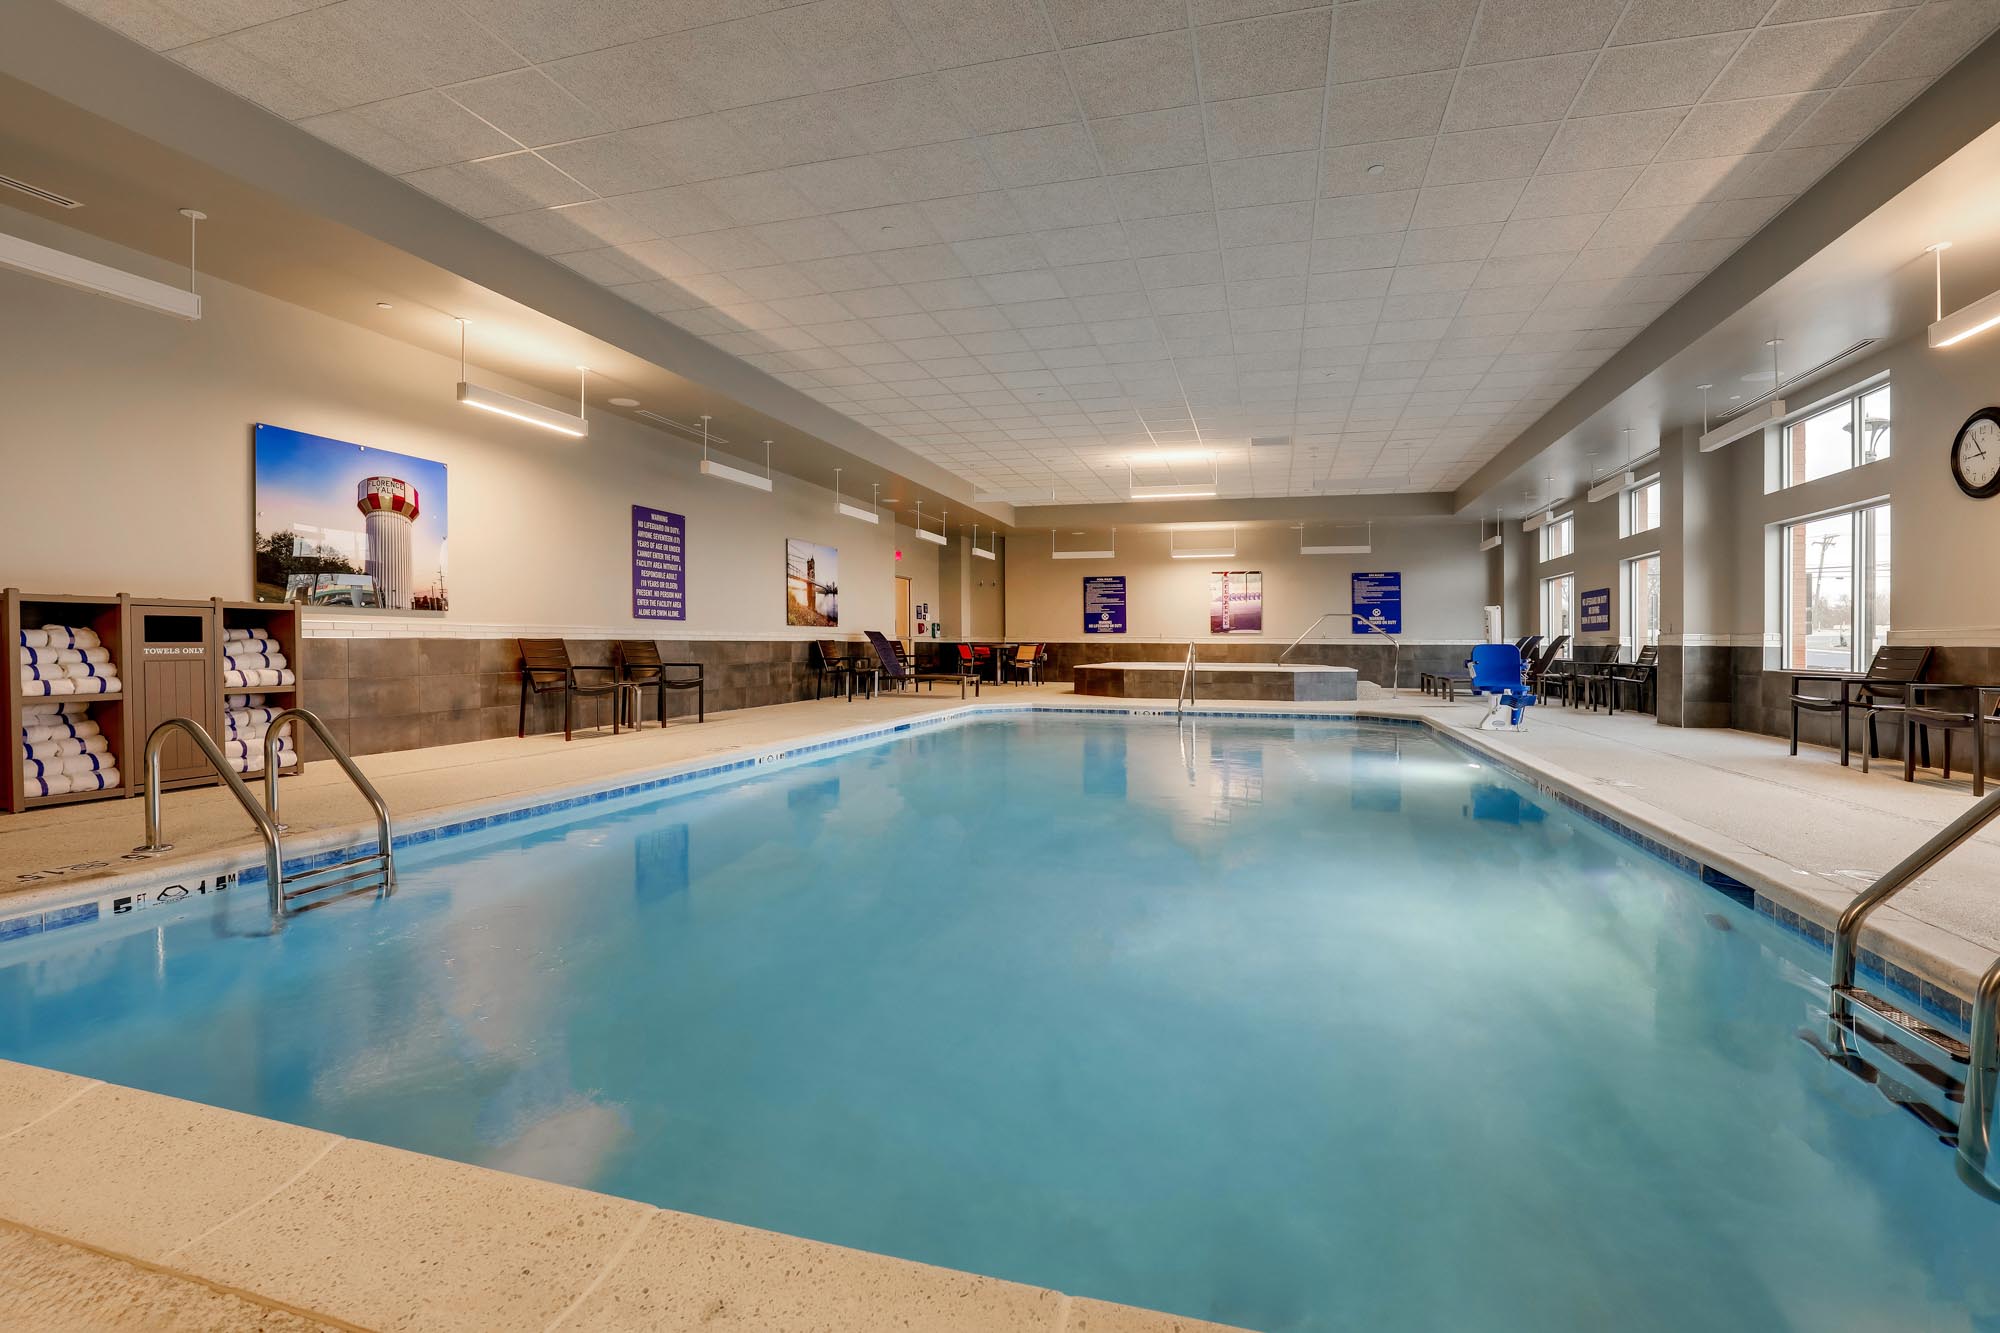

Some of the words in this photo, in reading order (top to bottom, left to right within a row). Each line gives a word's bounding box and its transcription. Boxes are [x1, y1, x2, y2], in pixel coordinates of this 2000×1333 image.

[1980, 425, 1986, 434] 12
[1962, 454, 1968, 462] 9
[1966, 466, 1970, 474] 8
[1990, 467, 1996, 476] 5
[1972, 472, 1977, 481] 7
[1981, 473, 1986, 482] 6
[368, 480, 404, 490] FLORENCE
[651, 513, 668, 522] WARNING
[644, 521, 664, 531] LIFEGUARD
[638, 530, 652, 539] ANYONE
[653, 533, 672, 542] SEVENTEEN
[637, 540, 649, 548] YEARS
[669, 545, 680, 553] UNDER
[641, 570, 666, 579] RESPONSIBLE
[114, 896, 132, 914] 5
[136, 893, 147, 904] FT
